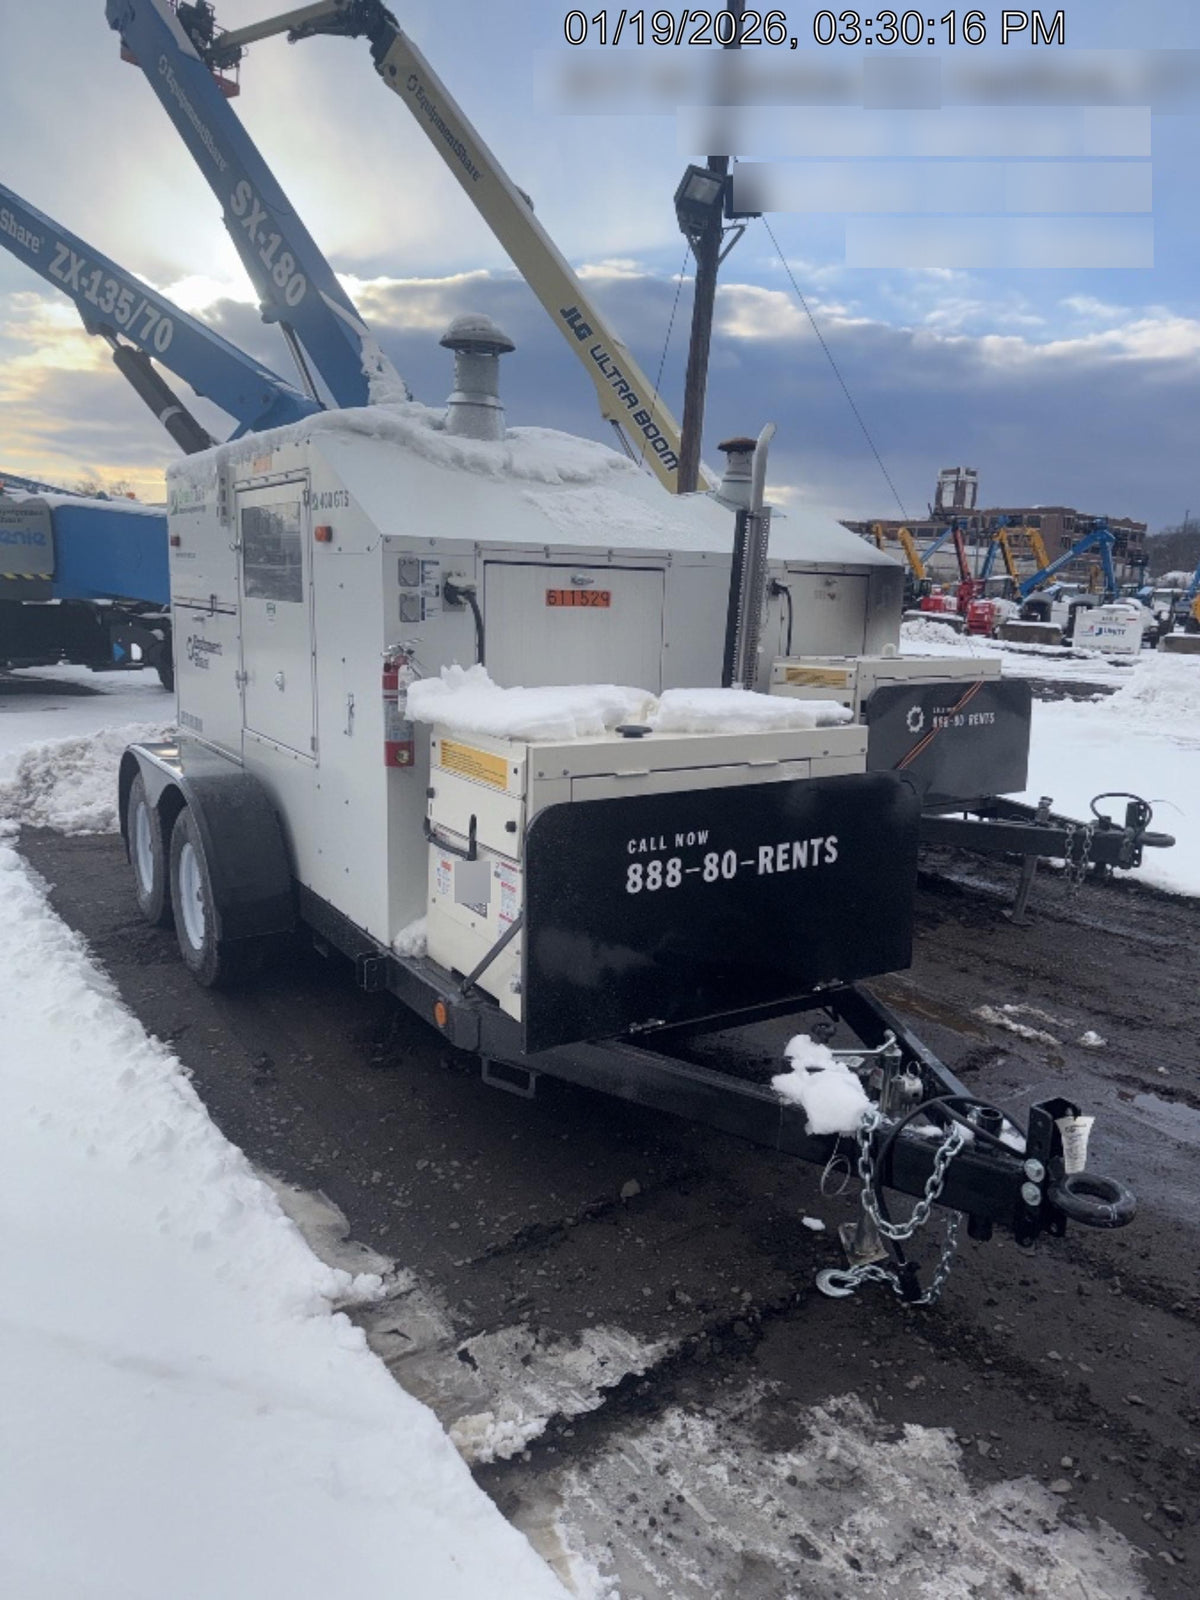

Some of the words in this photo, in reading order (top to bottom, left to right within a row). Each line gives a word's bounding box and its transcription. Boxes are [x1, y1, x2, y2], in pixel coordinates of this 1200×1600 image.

[415, 85, 481, 182] EquipmentShare
[230, 180, 307, 306] SX-180
[48, 241, 174, 353] ZX-135/70
[559, 306, 593, 342] JLG
[590, 343, 640, 410] ULTRA
[632, 408, 679, 472] BOOM
[547, 589, 610, 606] 611529
[625, 835, 839, 894] 888-80-RENTS
[627, 835, 667, 854] CALL
[675, 829, 710, 848] NOW
